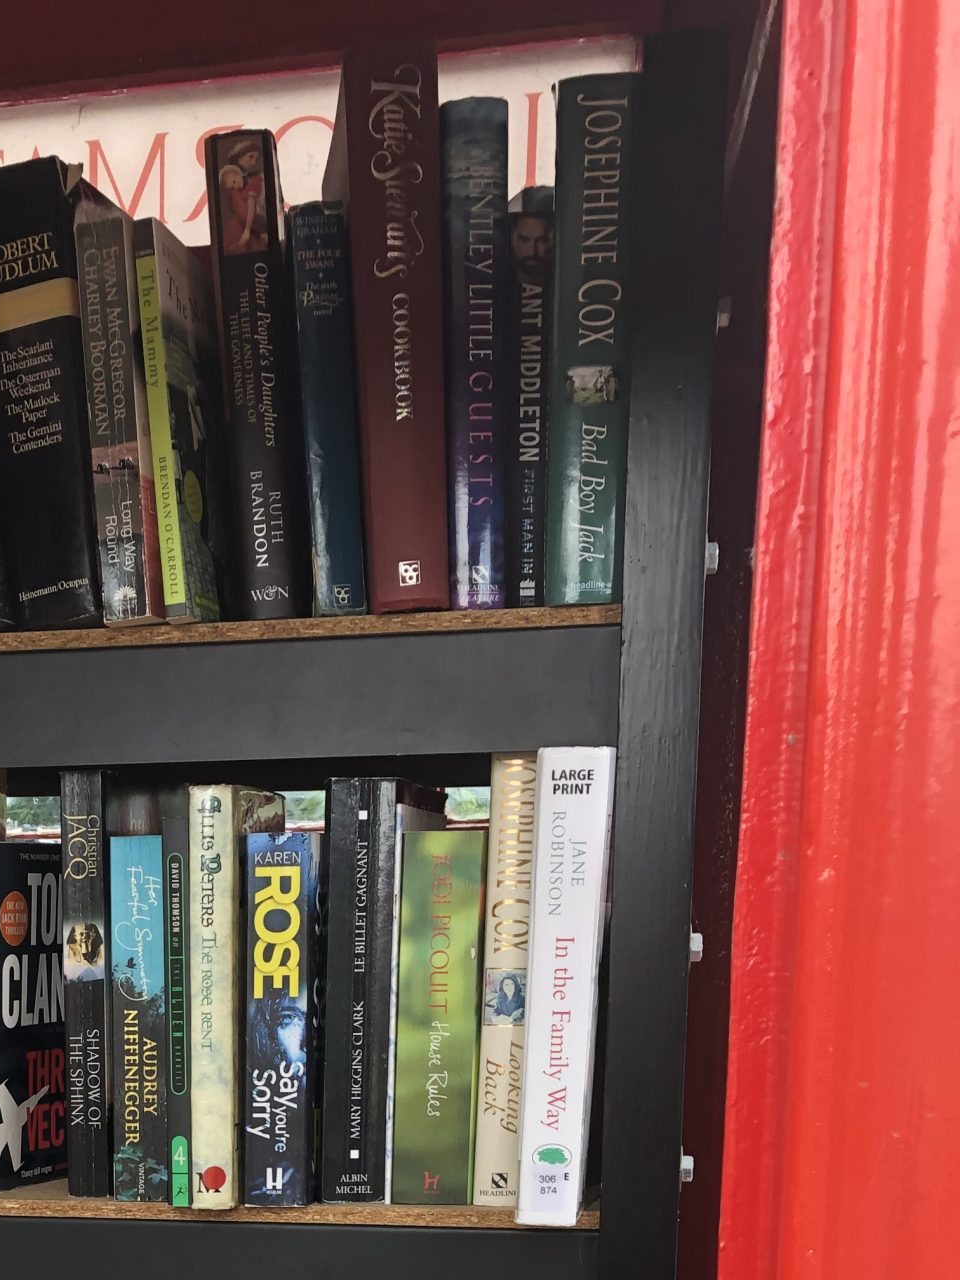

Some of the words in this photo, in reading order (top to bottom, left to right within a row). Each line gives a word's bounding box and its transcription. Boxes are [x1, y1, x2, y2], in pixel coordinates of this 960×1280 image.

[577, 94, 628, 265] JOSEPHINE
[253, 262, 267, 308] Other
[521, 283, 542, 327] ANT
[256, 310, 272, 368] People's
[467, 284, 494, 363] LITTLE
[575, 279, 622, 347] COX
[391, 292, 414, 423] COOKBOOK
[258, 369, 276, 447] Daughters
[519, 336, 541, 461] MIDDLETON
[468, 370, 495, 508] GUESTS
[249, 469, 269, 569] BRANDON
[267, 490, 285, 543] RUTH
[551, 768, 594, 782] LARGE
[552, 782, 591, 796] PRINT
[63, 814, 89, 881] JACQ
[254, 851, 301, 865] KAREN
[356, 840, 369, 907] GAGNANT
[547, 810, 566, 918] ROBINSON
[570, 839, 587, 888] JANE
[252, 865, 301, 999] ROSE
[355, 910, 367, 954] BILLET
[554, 936, 575, 958] In
[355, 957, 365, 973] LE
[552, 961, 572, 1000] the
[353, 1000, 365, 1043] CLARK
[544, 1008, 574, 1081] Family
[70, 1032, 83, 1066] THE
[70, 1070, 84, 1127] SPHINX
[123, 1009, 141, 1146] NIFFENEGGER
[142, 1037, 159, 1117] AUDREY
[352, 1048, 363, 1104] HIGGINS
[350, 1108, 361, 1140] MARY
[541, 1086, 568, 1133] Way
[335, 1185, 374, 1195] MICHEL
[340, 1173, 369, 1183] ALBIN
[538, 1174, 557, 1184] 306
[539, 1186, 557, 1195] 874
